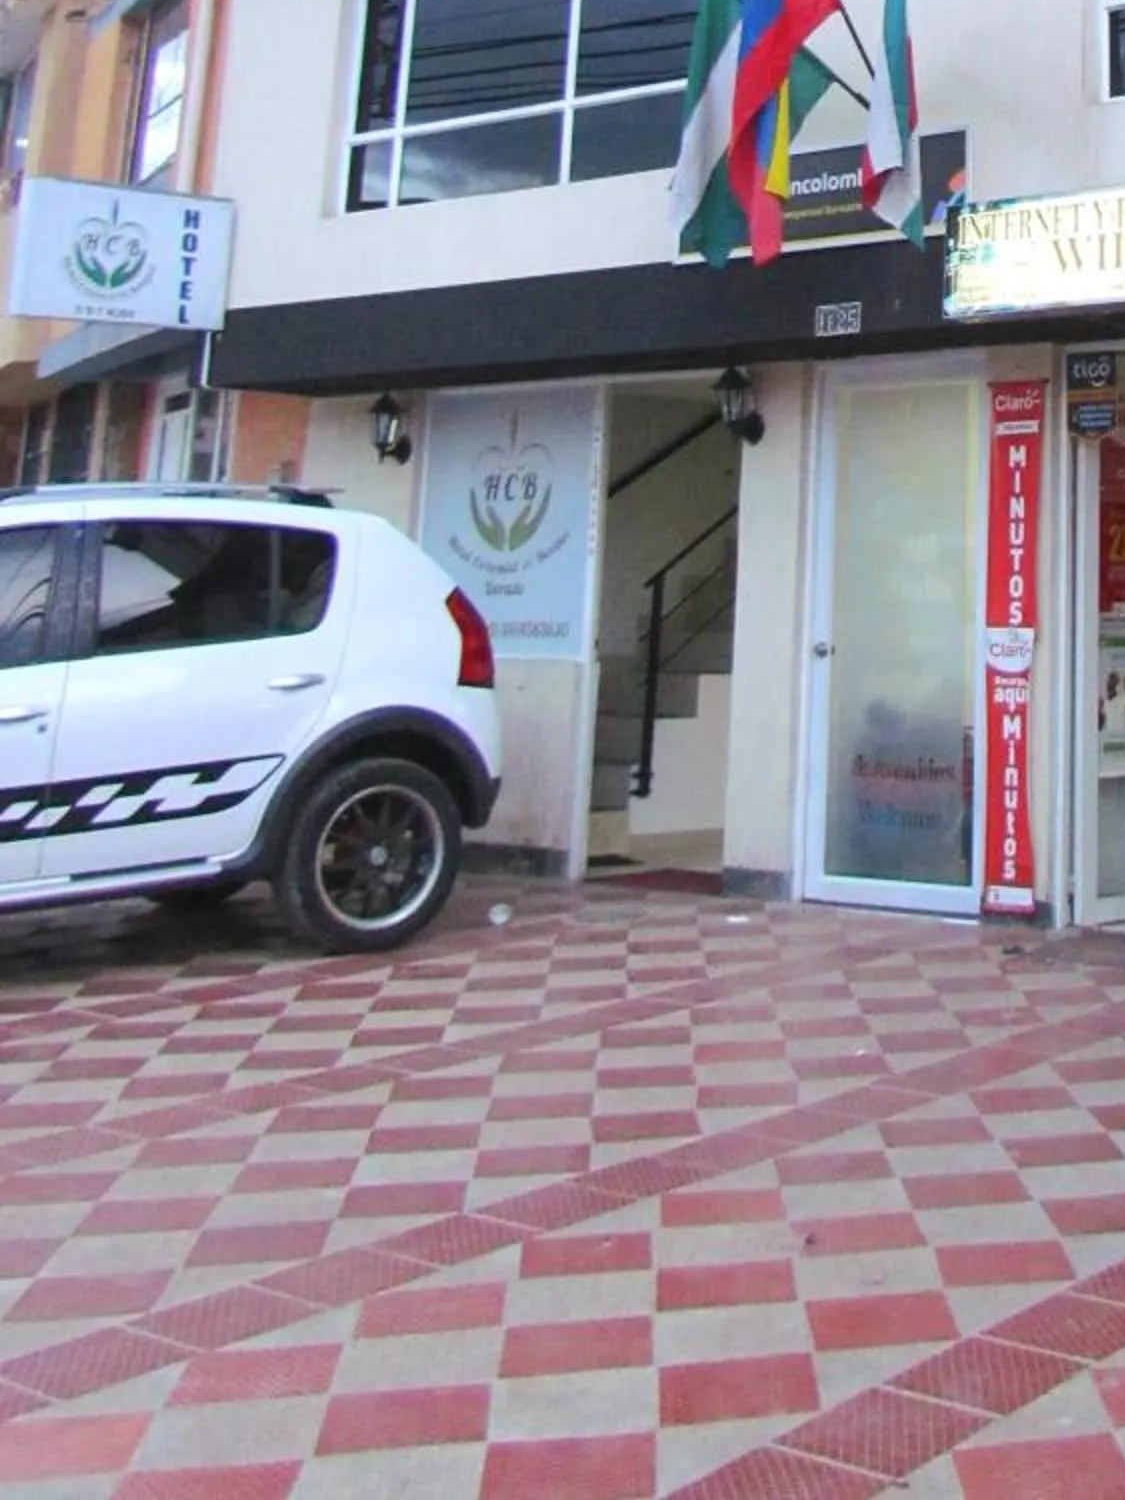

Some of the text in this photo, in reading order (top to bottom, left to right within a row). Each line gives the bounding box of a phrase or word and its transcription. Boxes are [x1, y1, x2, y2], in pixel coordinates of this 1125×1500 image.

[790, 167, 863, 196] ncolom
[959, 201, 1085, 246] INTERNET
[1093, 201, 1108, 230] Y
[178, 209, 200, 325] HOTEL
[1073, 357, 1111, 387] tigo
[995, 390, 1034, 412] Claro
[1008, 445, 1027, 624] MINUTOS
[1003, 715, 1022, 880] Minutos
